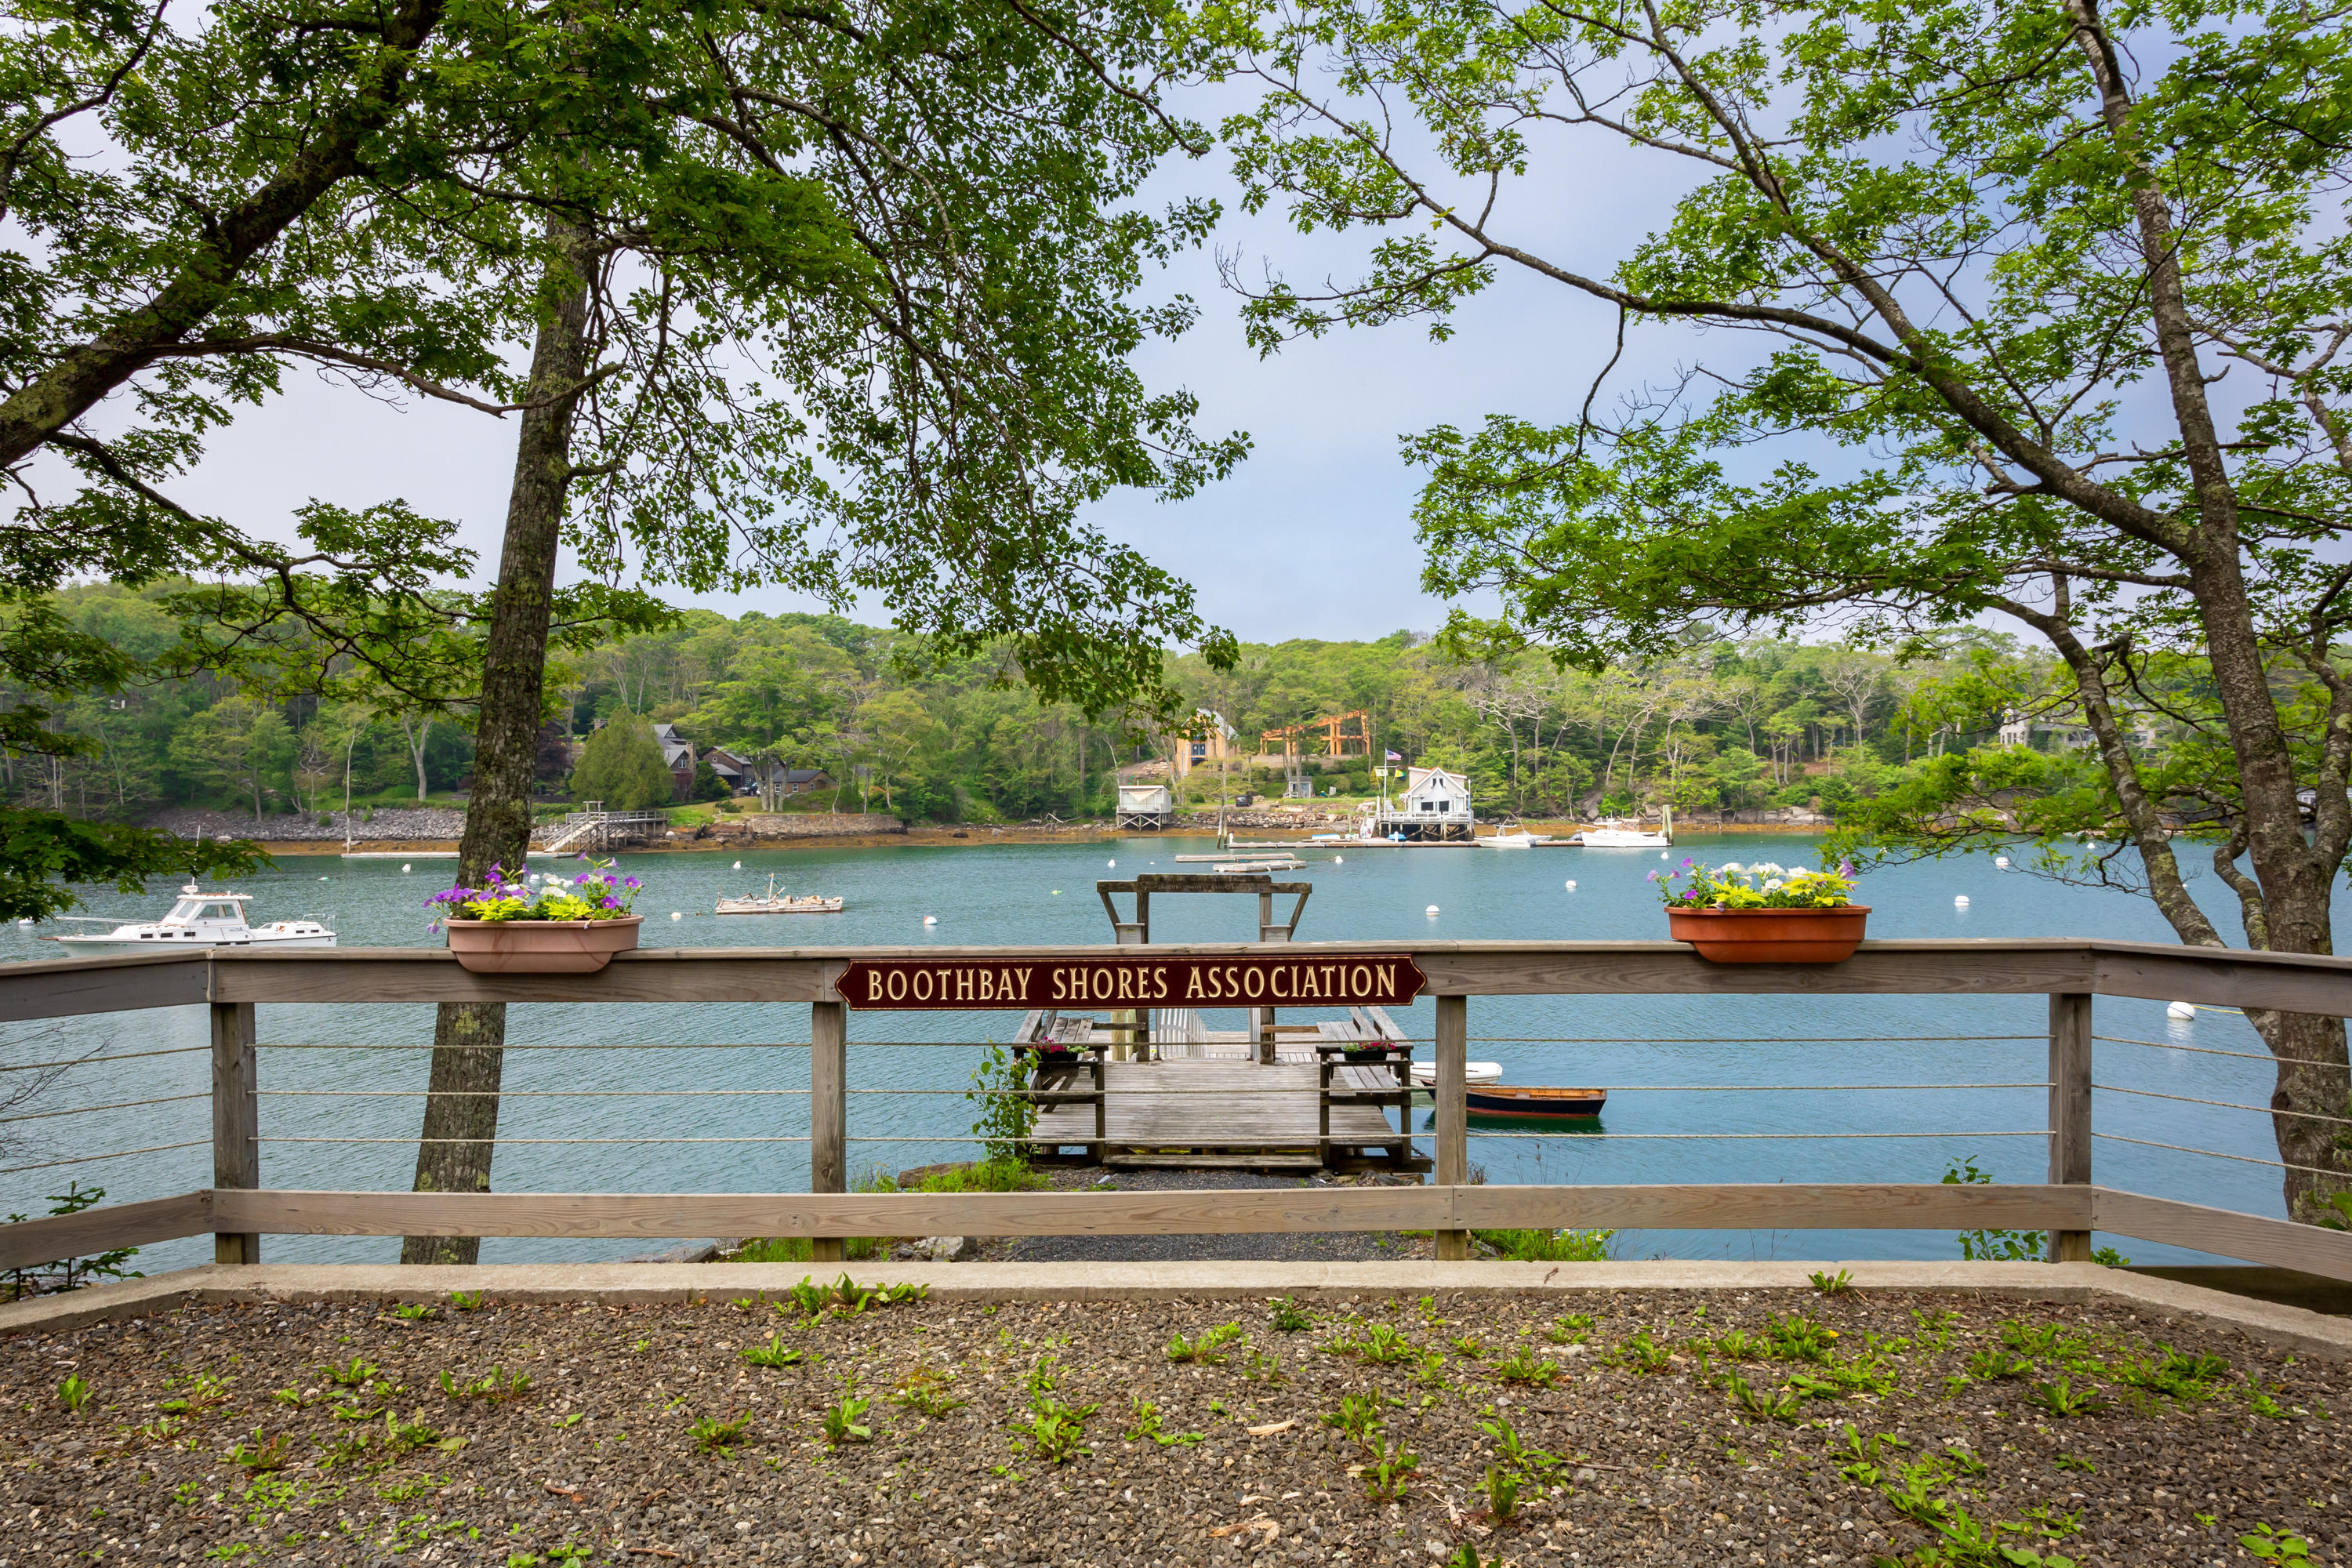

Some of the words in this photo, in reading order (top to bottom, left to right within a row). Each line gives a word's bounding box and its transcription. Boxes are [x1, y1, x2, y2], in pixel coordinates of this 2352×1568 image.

[868, 967, 1032, 1000] BOOTHBAY
[1052, 967, 1167, 1000] SHORES
[1185, 964, 1396, 998] ASSOCIATION
